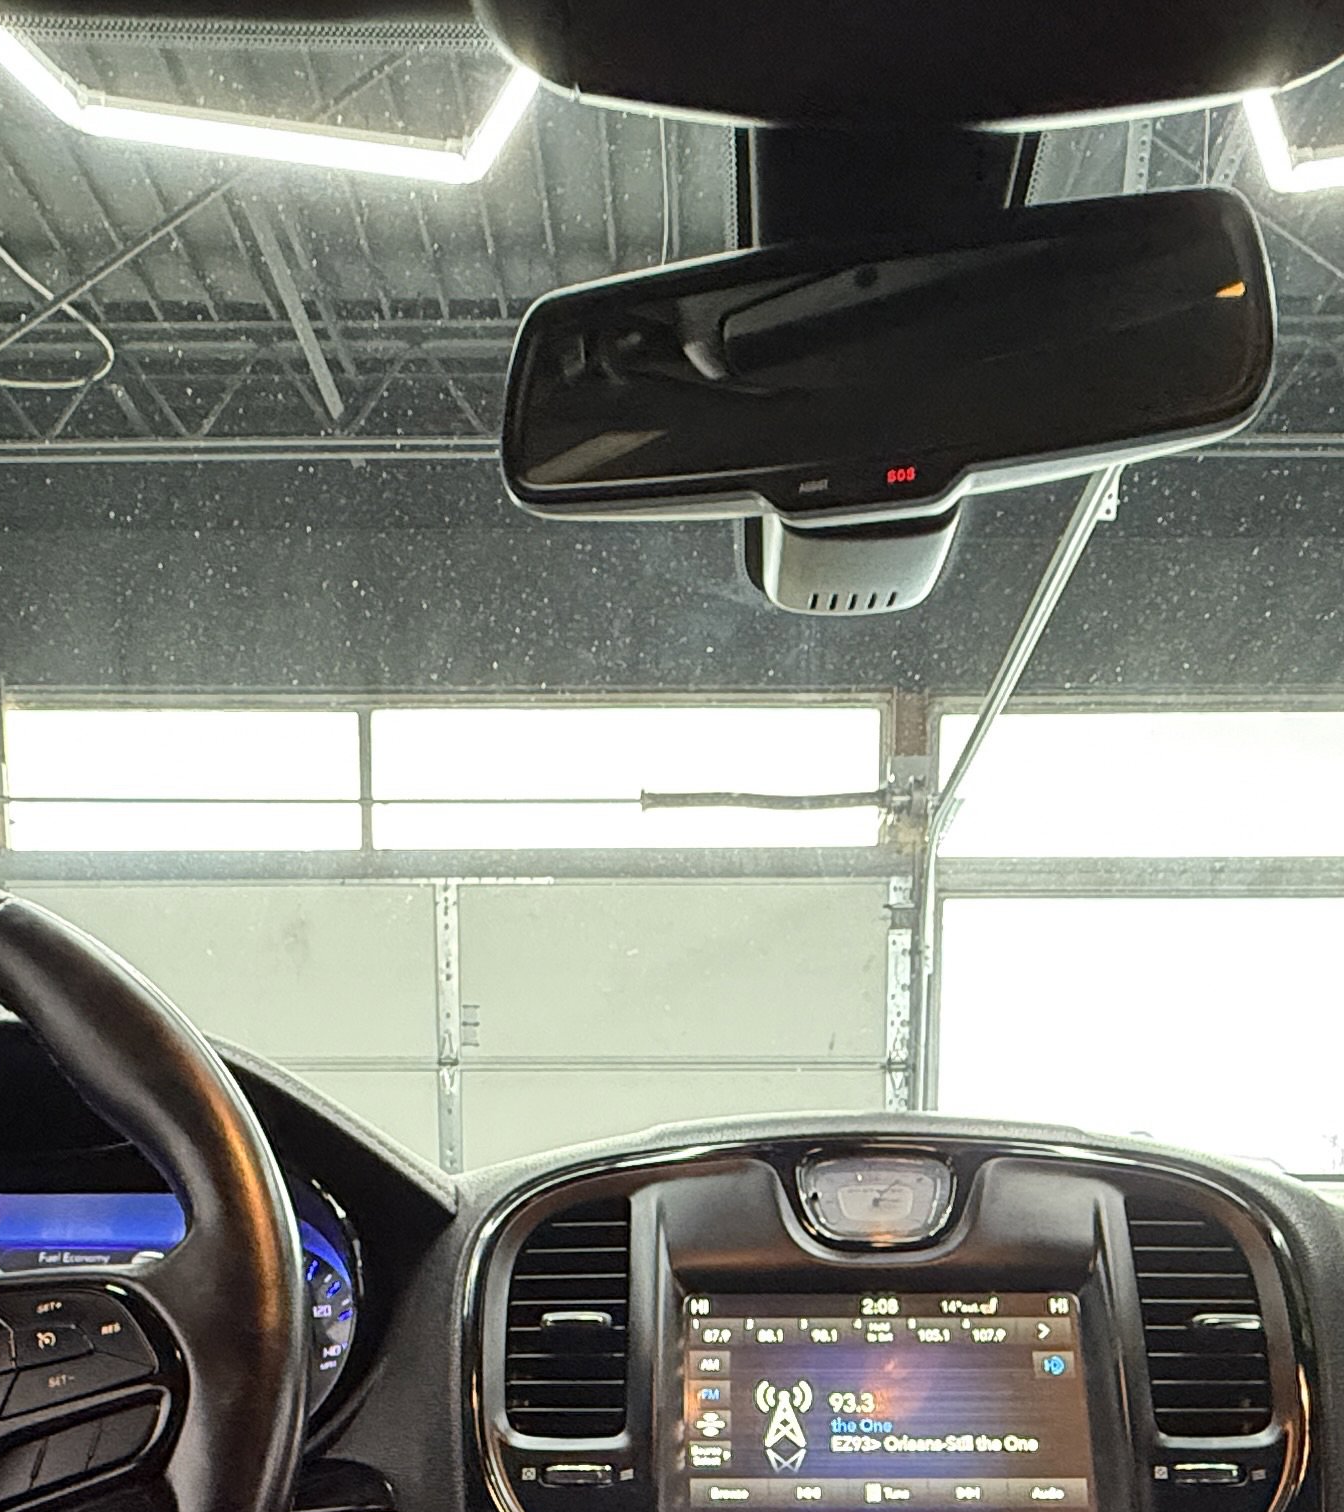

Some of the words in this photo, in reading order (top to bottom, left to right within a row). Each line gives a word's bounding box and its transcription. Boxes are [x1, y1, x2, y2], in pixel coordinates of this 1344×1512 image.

[886, 466, 916, 484] SOS
[38, 1252, 61, 1264] Fuel
[62, 1252, 111, 1265] Economy
[312, 1305, 332, 1318] 120
[700, 1388, 721, 1401] FM
[828, 1392, 875, 1413] 93.3
[830, 1417, 857, 1433] the
[859, 1418, 893, 1433] One
[975, 1435, 1003, 1452] the
[1003, 1434, 1040, 1452] One
